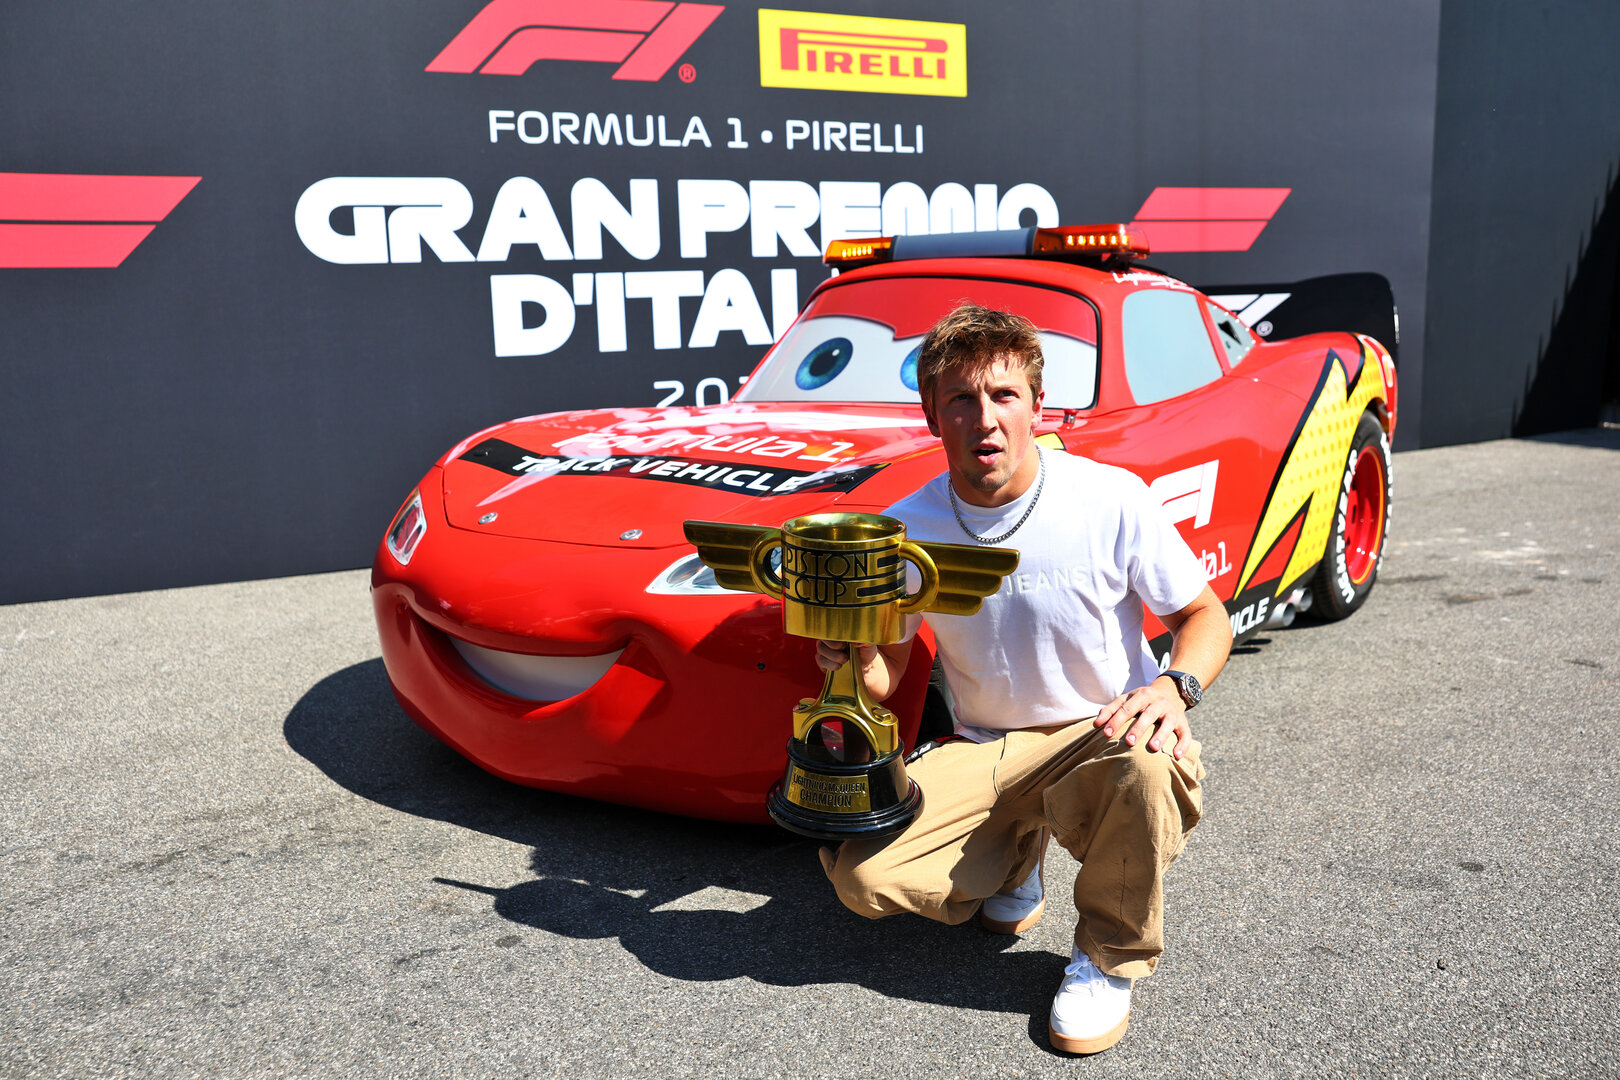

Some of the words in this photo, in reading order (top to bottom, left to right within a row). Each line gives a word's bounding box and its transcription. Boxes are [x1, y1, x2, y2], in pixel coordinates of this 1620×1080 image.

[779, 27, 949, 80] PIRELLI
[489, 110, 712, 148] FORMULA
[727, 117, 749, 149] 1
[785, 119, 924, 154] PIRELLI
[295, 176, 661, 264] GRAN
[677, 178, 1059, 258] PREMIO
[490, 268, 839, 357] D'ITAL
[653, 377, 749, 408] 20
[551, 432, 807, 457] Formula
[797, 441, 855, 463] 1
[512, 455, 630, 473] TRACK
[629, 459, 812, 492] VEHICLE
[786, 546, 868, 578] PISTON
[794, 576, 847, 604] CUP
[1006, 565, 1089, 595] JEANS
[1230, 597, 1270, 639] ICLE
[793, 774, 828, 792] LIGHTNING
[800, 788, 852, 808] CHAMPION
